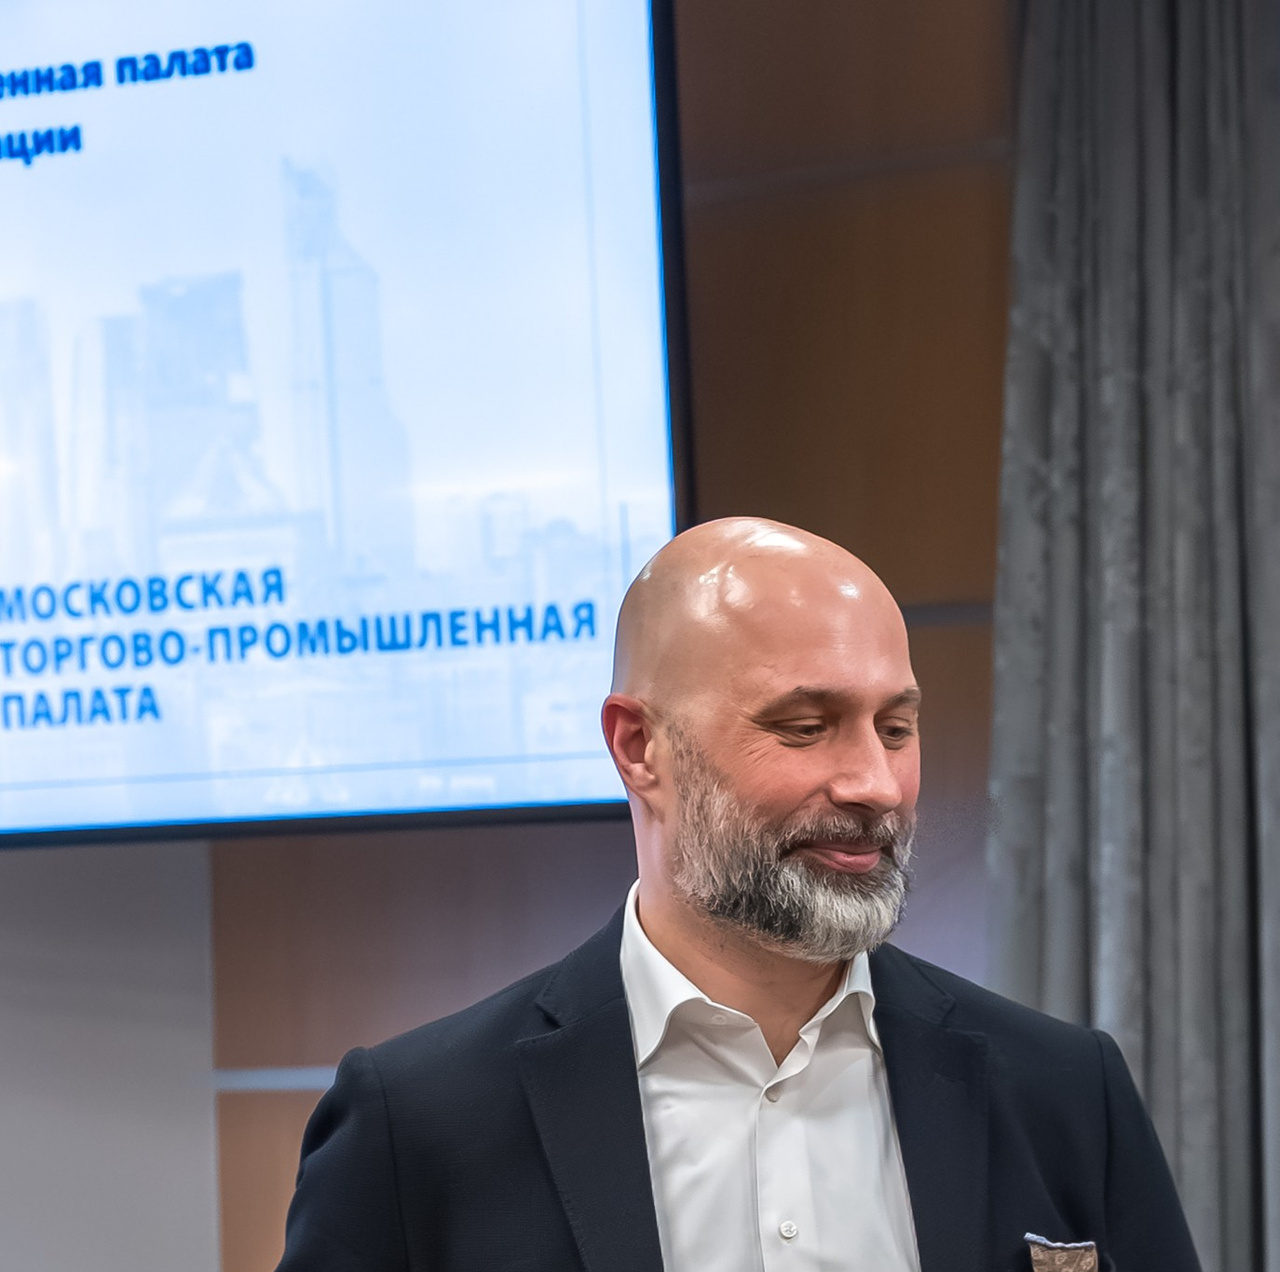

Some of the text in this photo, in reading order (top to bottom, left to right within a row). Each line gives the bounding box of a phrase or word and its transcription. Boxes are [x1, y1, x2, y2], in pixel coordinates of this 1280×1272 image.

[116, 41, 255, 84] палата
[0, 567, 284, 622] МОСКОВСКАЯ
[0, 601, 597, 675] ТОРГОВО-ПРОМЫШЛЕННАЯ
[2, 686, 160, 729] ПАЛАТА
